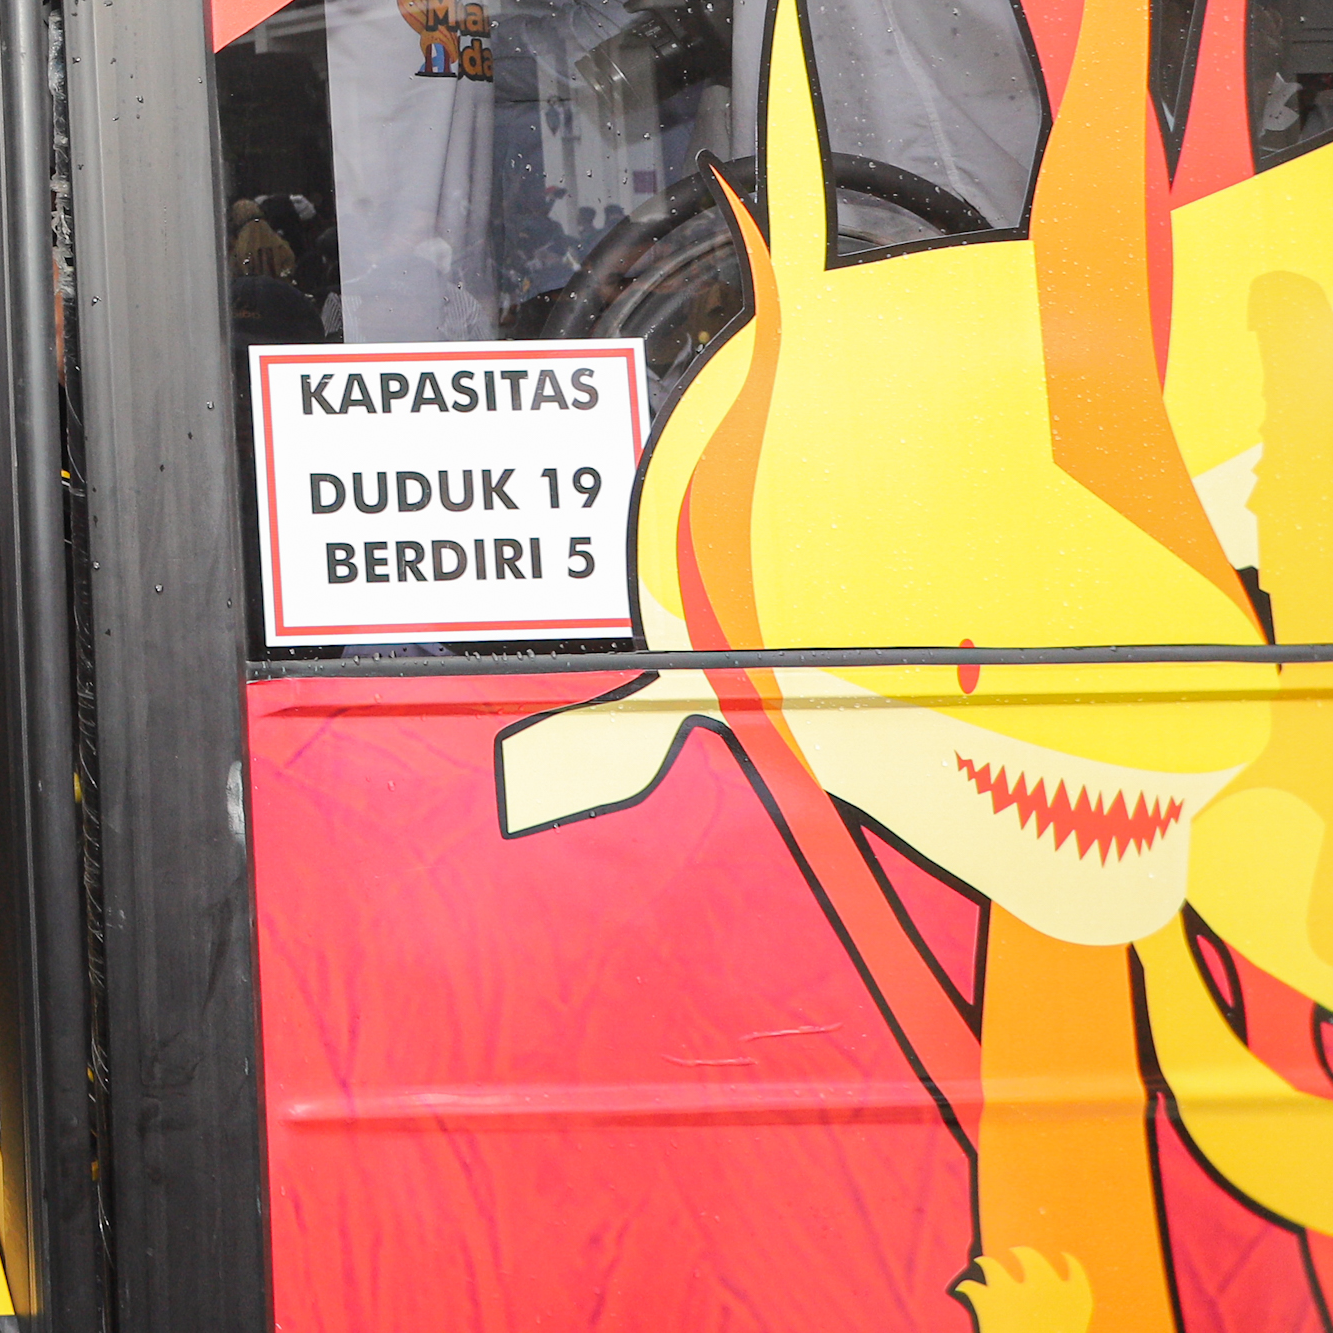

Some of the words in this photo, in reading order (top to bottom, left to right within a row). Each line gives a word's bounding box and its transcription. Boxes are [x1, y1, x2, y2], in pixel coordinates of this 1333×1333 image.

[300, 368, 599, 415] KAPASITAS
[309, 468, 518, 515] DUDUK
[541, 466, 602, 510] 19
[325, 537, 542, 584] BERDIRI
[566, 536, 597, 579] 5
